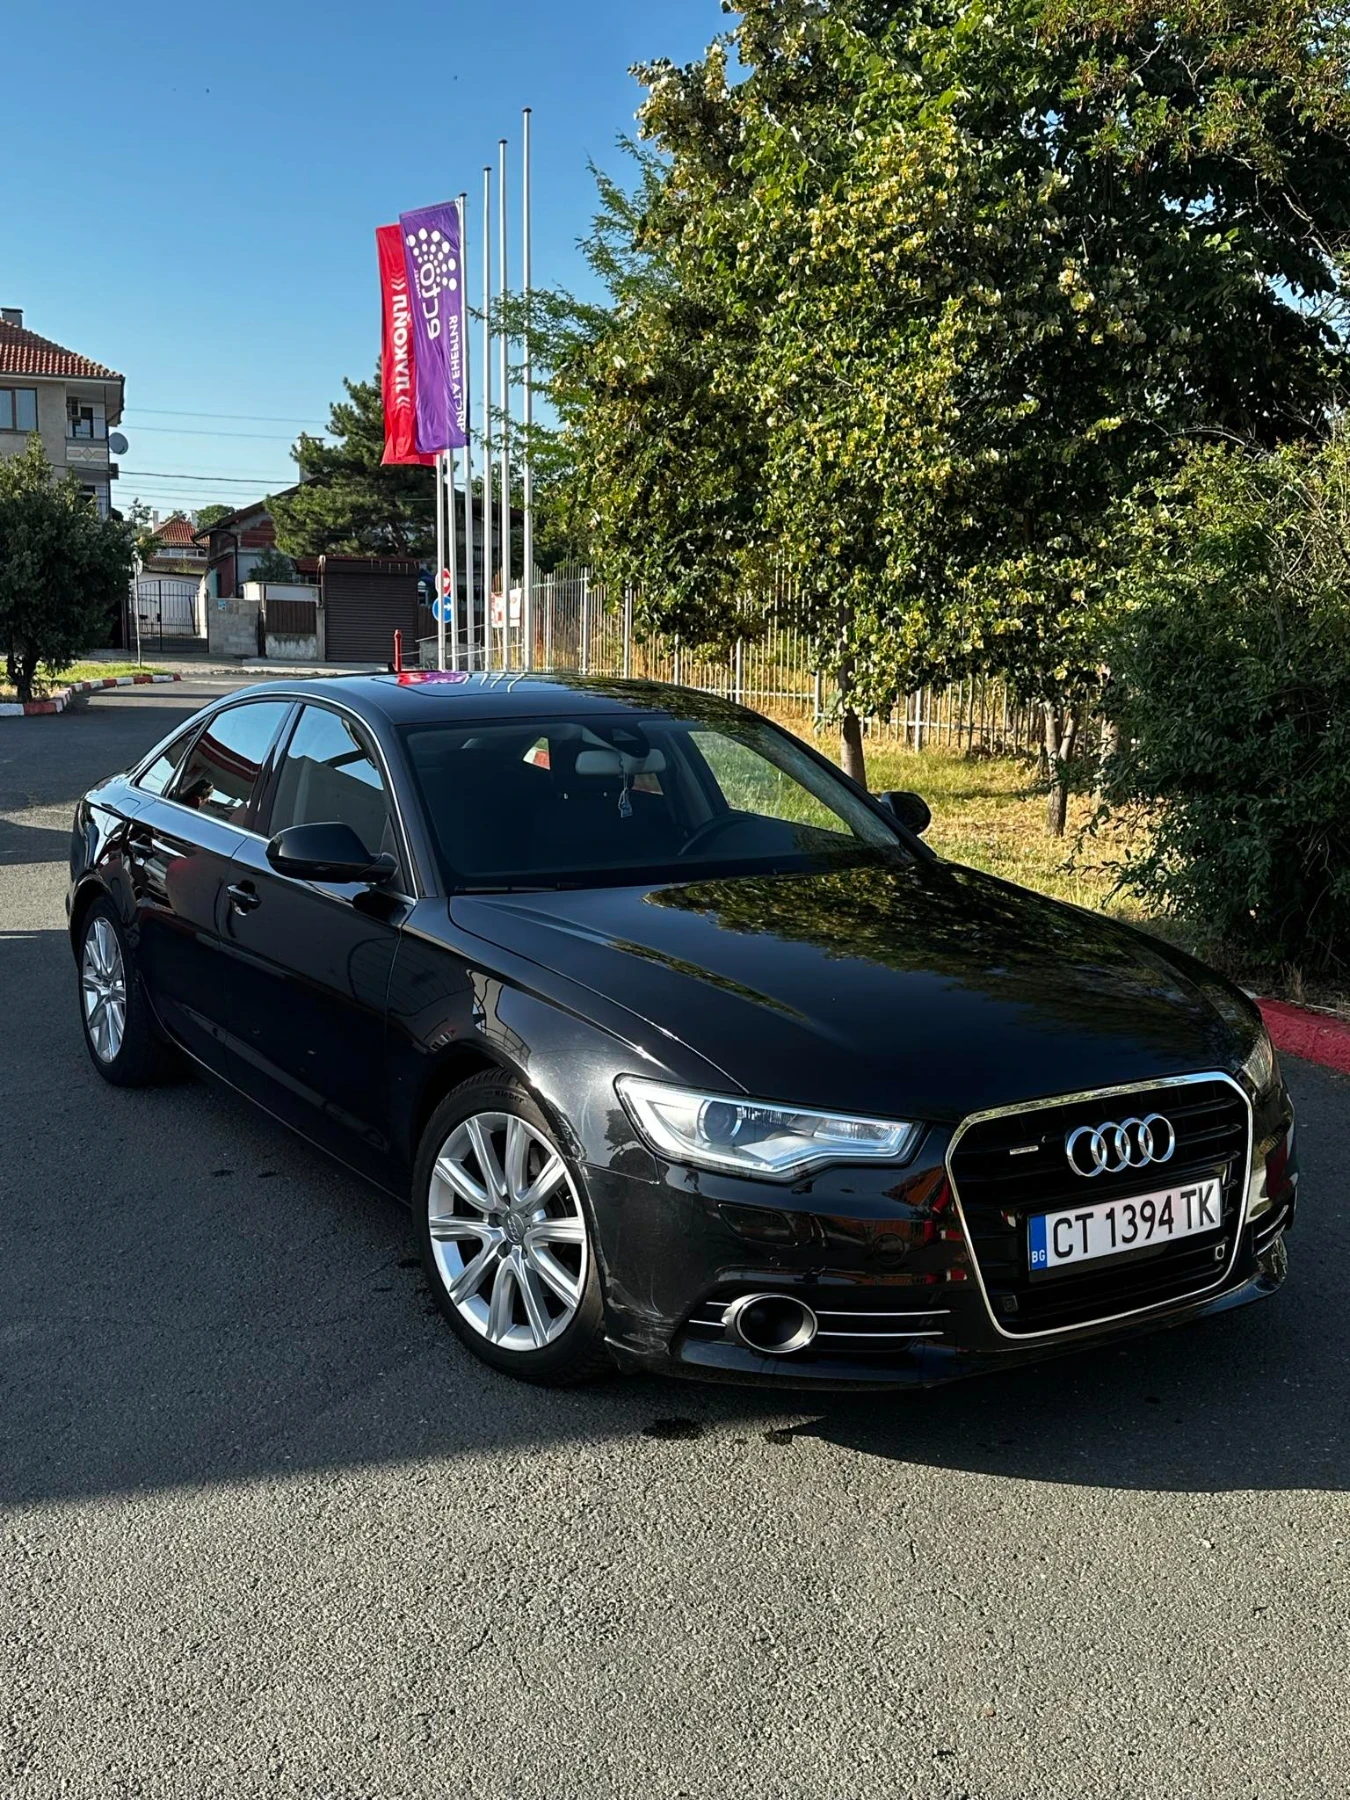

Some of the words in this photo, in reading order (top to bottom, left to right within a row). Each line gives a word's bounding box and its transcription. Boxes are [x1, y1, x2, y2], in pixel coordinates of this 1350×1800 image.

[1053, 1212, 1094, 1259] CT
[1105, 1196, 1174, 1249] 1394
[1180, 1183, 1216, 1229] TK
[1031, 1249, 1046, 1264] BG
